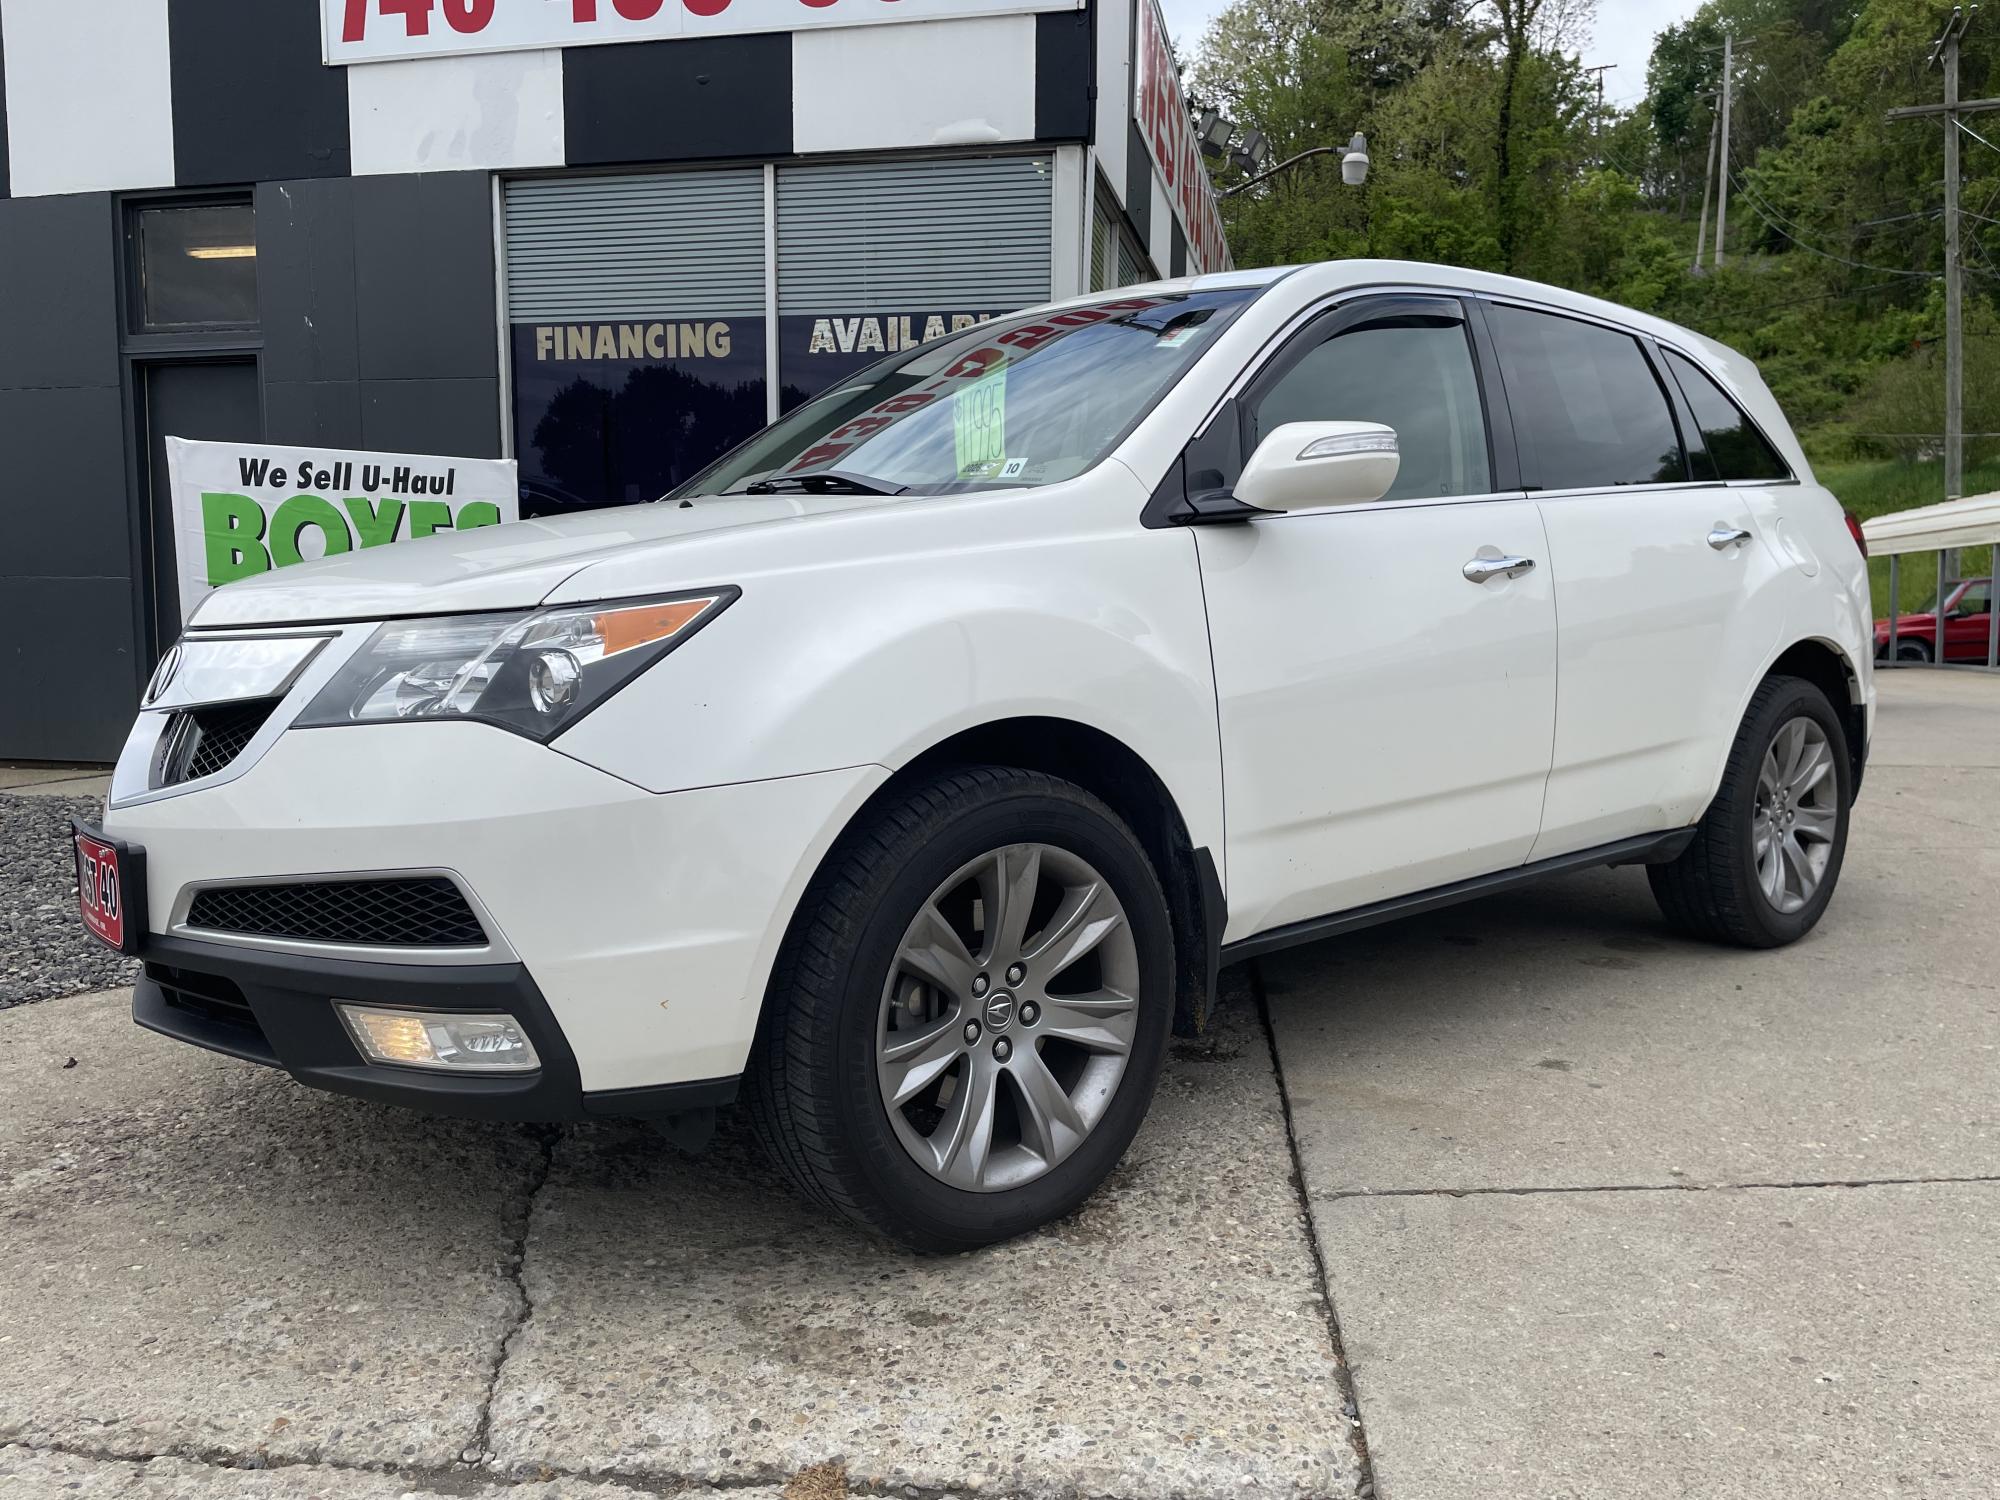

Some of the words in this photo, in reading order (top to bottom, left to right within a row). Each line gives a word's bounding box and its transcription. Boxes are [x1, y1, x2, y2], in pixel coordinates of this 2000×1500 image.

[1141, 0, 1183, 208] WEST
[536, 321, 731, 361] FINANCING
[809, 313, 1006, 353] AVAILA
[239, 457, 287, 488] We
[297, 460, 352, 490] Sell
[362, 464, 456, 495] U-Haul
[1006, 462, 1020, 474] 10
[201, 491, 501, 587] BOX
[101, 861, 119, 920] 40
